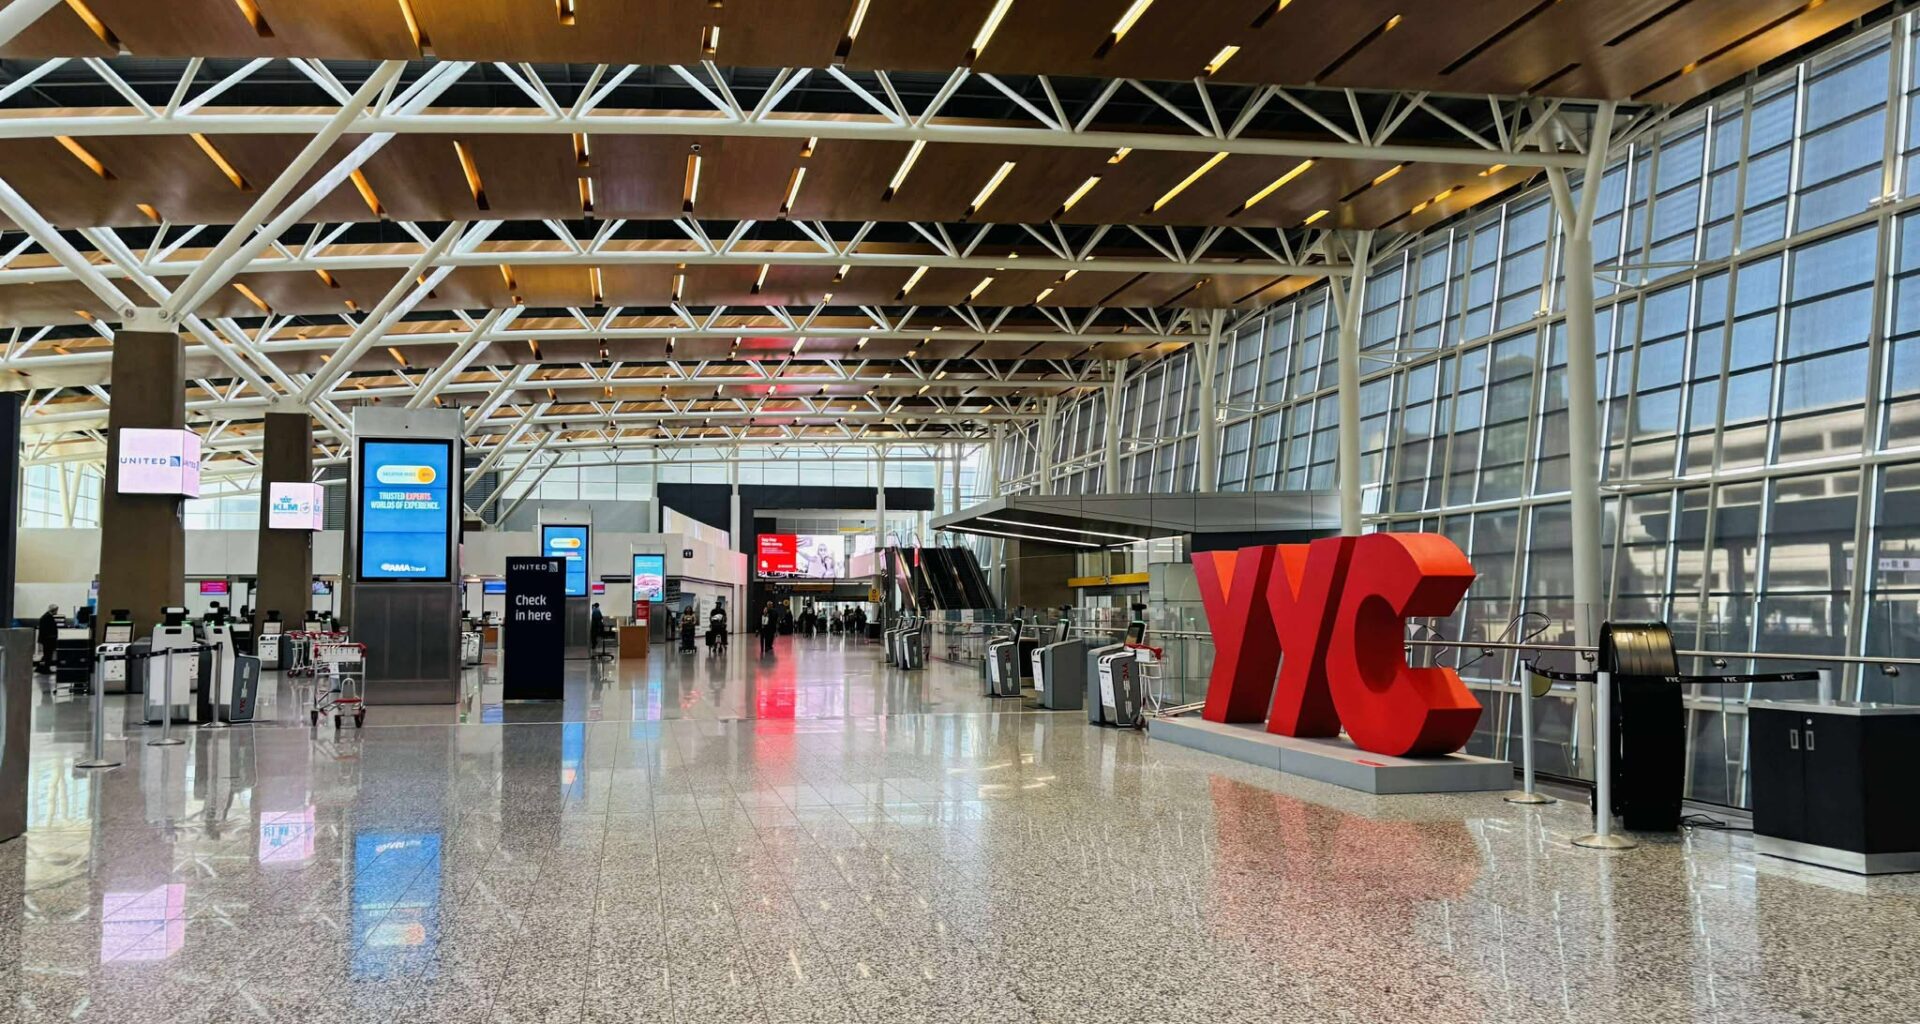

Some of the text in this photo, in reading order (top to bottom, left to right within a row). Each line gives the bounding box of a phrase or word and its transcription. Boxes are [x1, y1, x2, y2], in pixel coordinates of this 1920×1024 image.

[120, 457, 167, 465] UNITED
[379, 492, 405, 500] TRUSTED
[370, 500, 395, 509] WORLDS
[395, 501, 404, 509] OF
[176, 501, 182, 523] 4
[389, 564, 410, 572] AMA
[515, 594, 547, 606] Check
[515, 609, 552, 621] in here
[1191, 532, 1483, 757] YYC
